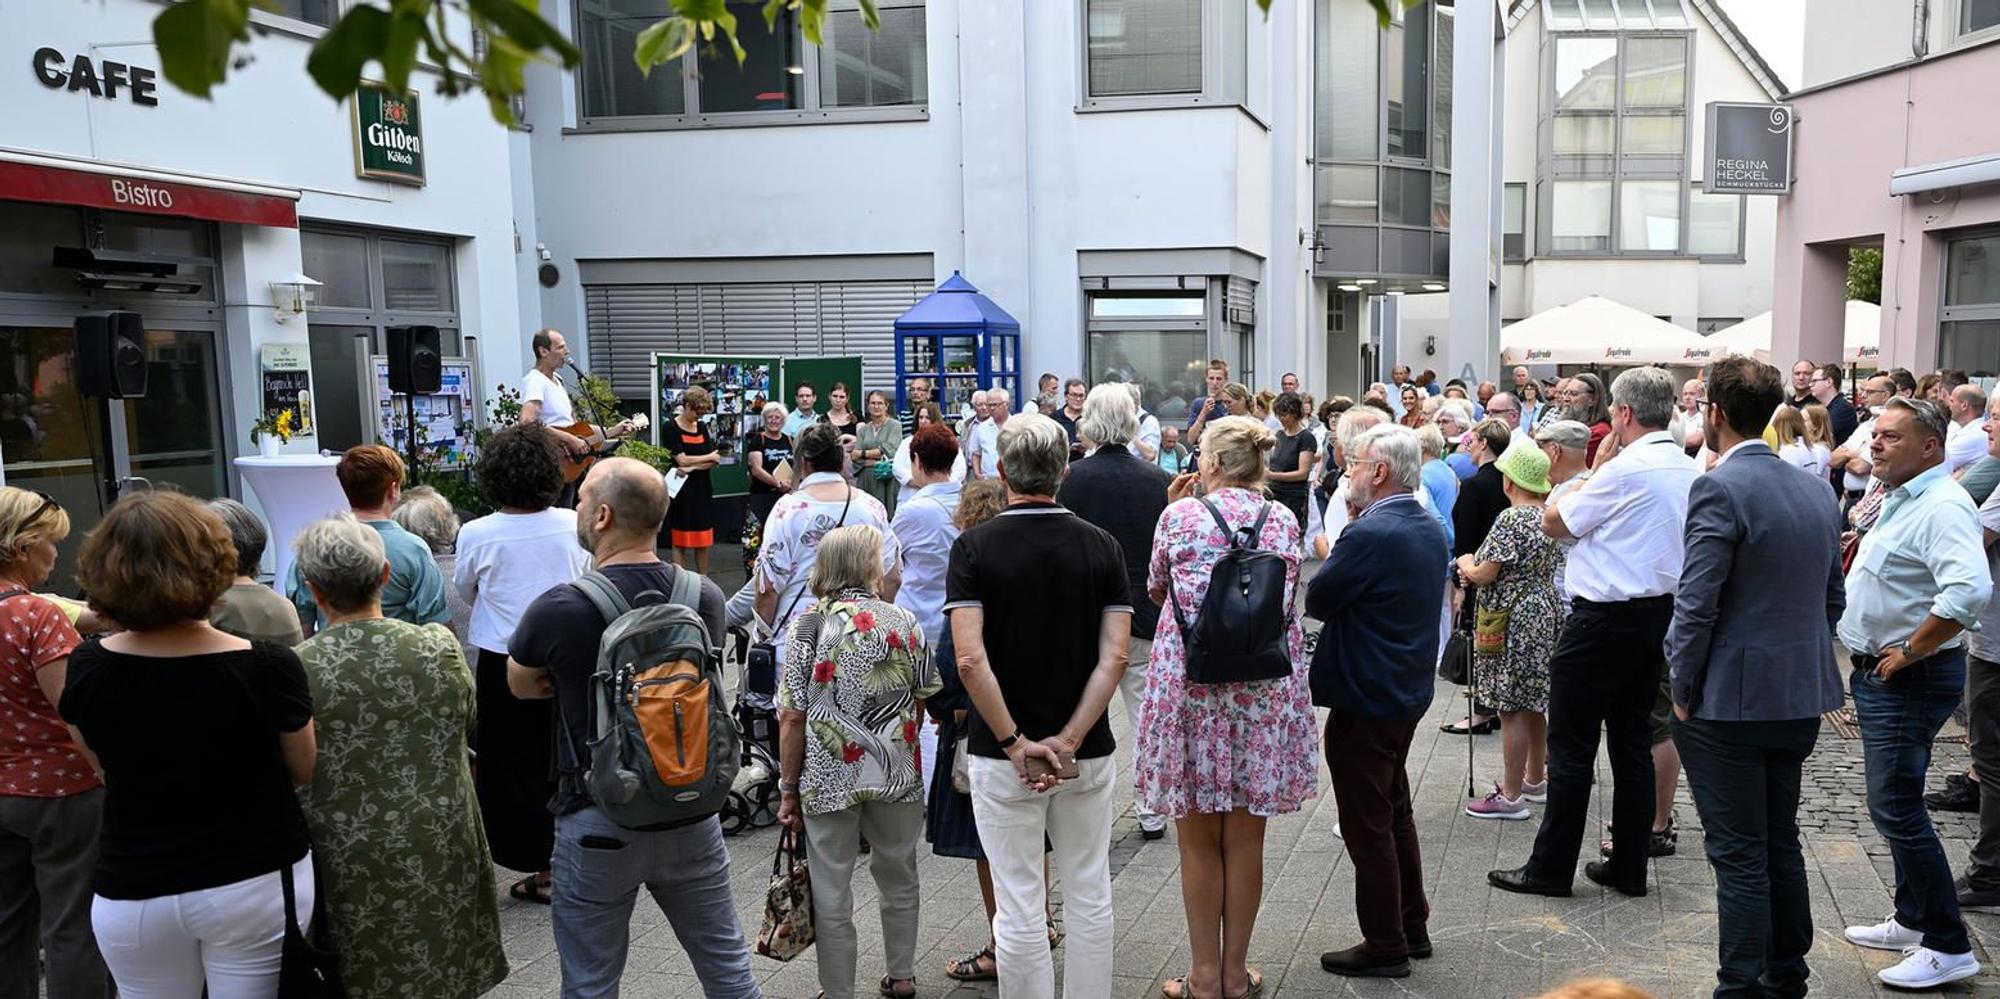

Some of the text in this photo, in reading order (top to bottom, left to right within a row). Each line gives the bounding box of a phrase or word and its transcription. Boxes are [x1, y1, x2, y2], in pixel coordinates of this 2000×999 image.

[33, 47, 158, 106] CAFE
[368, 122, 420, 154] Gilden
[386, 150, 413, 166] Kölsch
[1717, 159, 1769, 170] REGINA
[1716, 169, 1769, 181] HECKEL
[111, 179, 173, 208] Bistro
